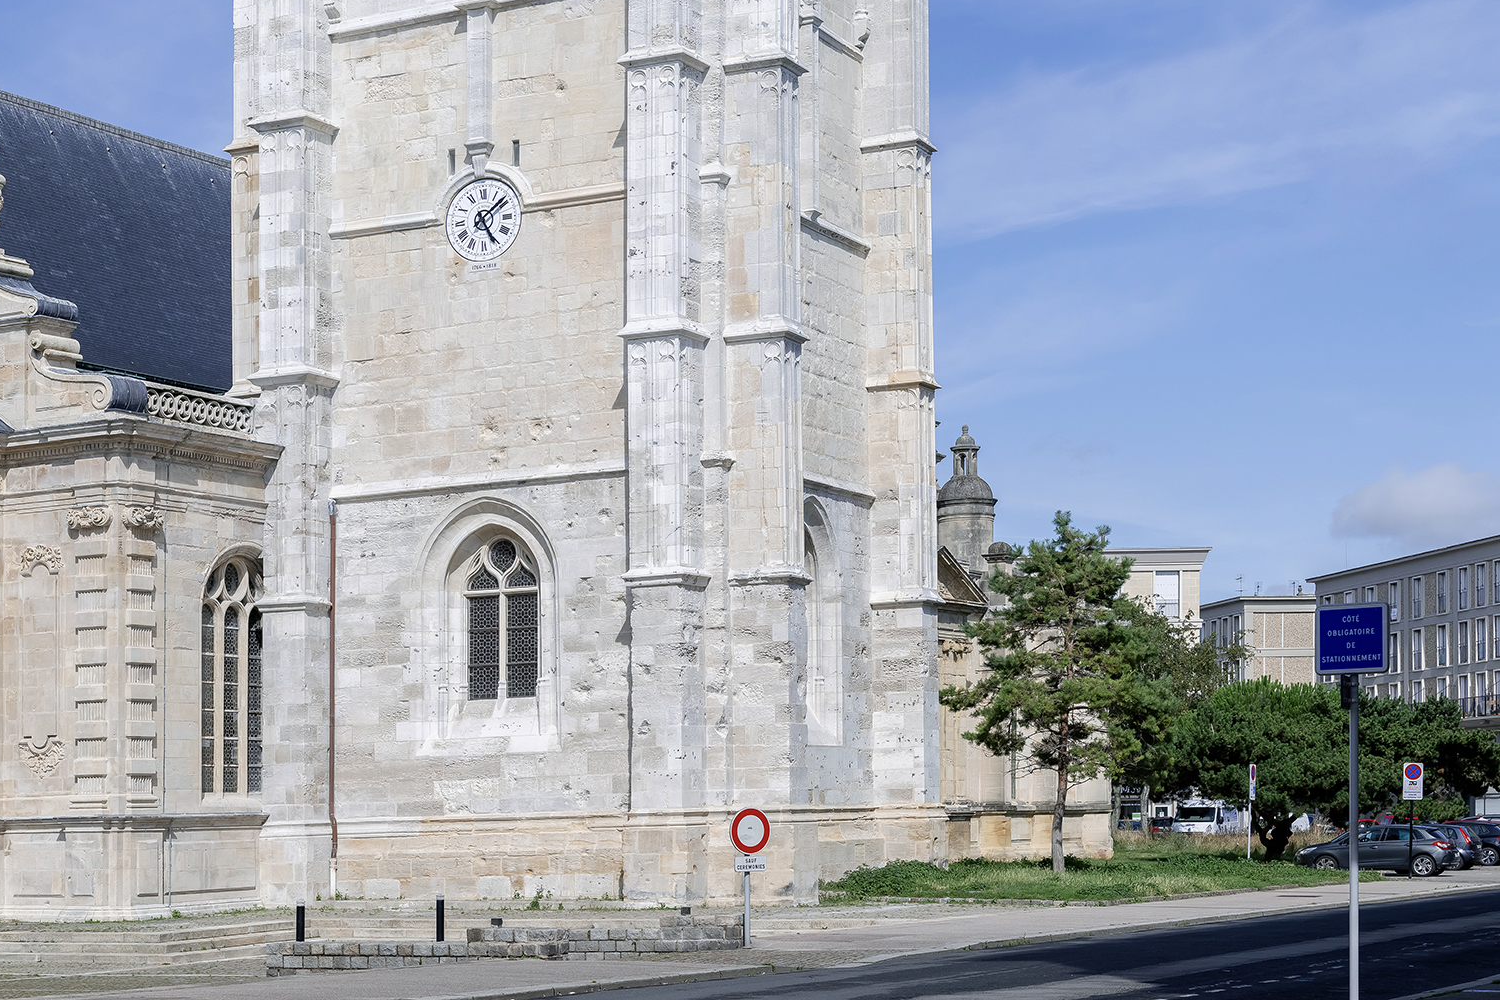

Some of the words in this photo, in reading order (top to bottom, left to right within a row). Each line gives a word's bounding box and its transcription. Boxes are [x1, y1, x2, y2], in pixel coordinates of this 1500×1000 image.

[1341, 614, 1360, 623] CÔTÉ
[1327, 627, 1375, 637] OBLIGATOIRE
[1346, 641, 1356, 649] DE
[1321, 653, 1381, 663] STATIONNEMENT
